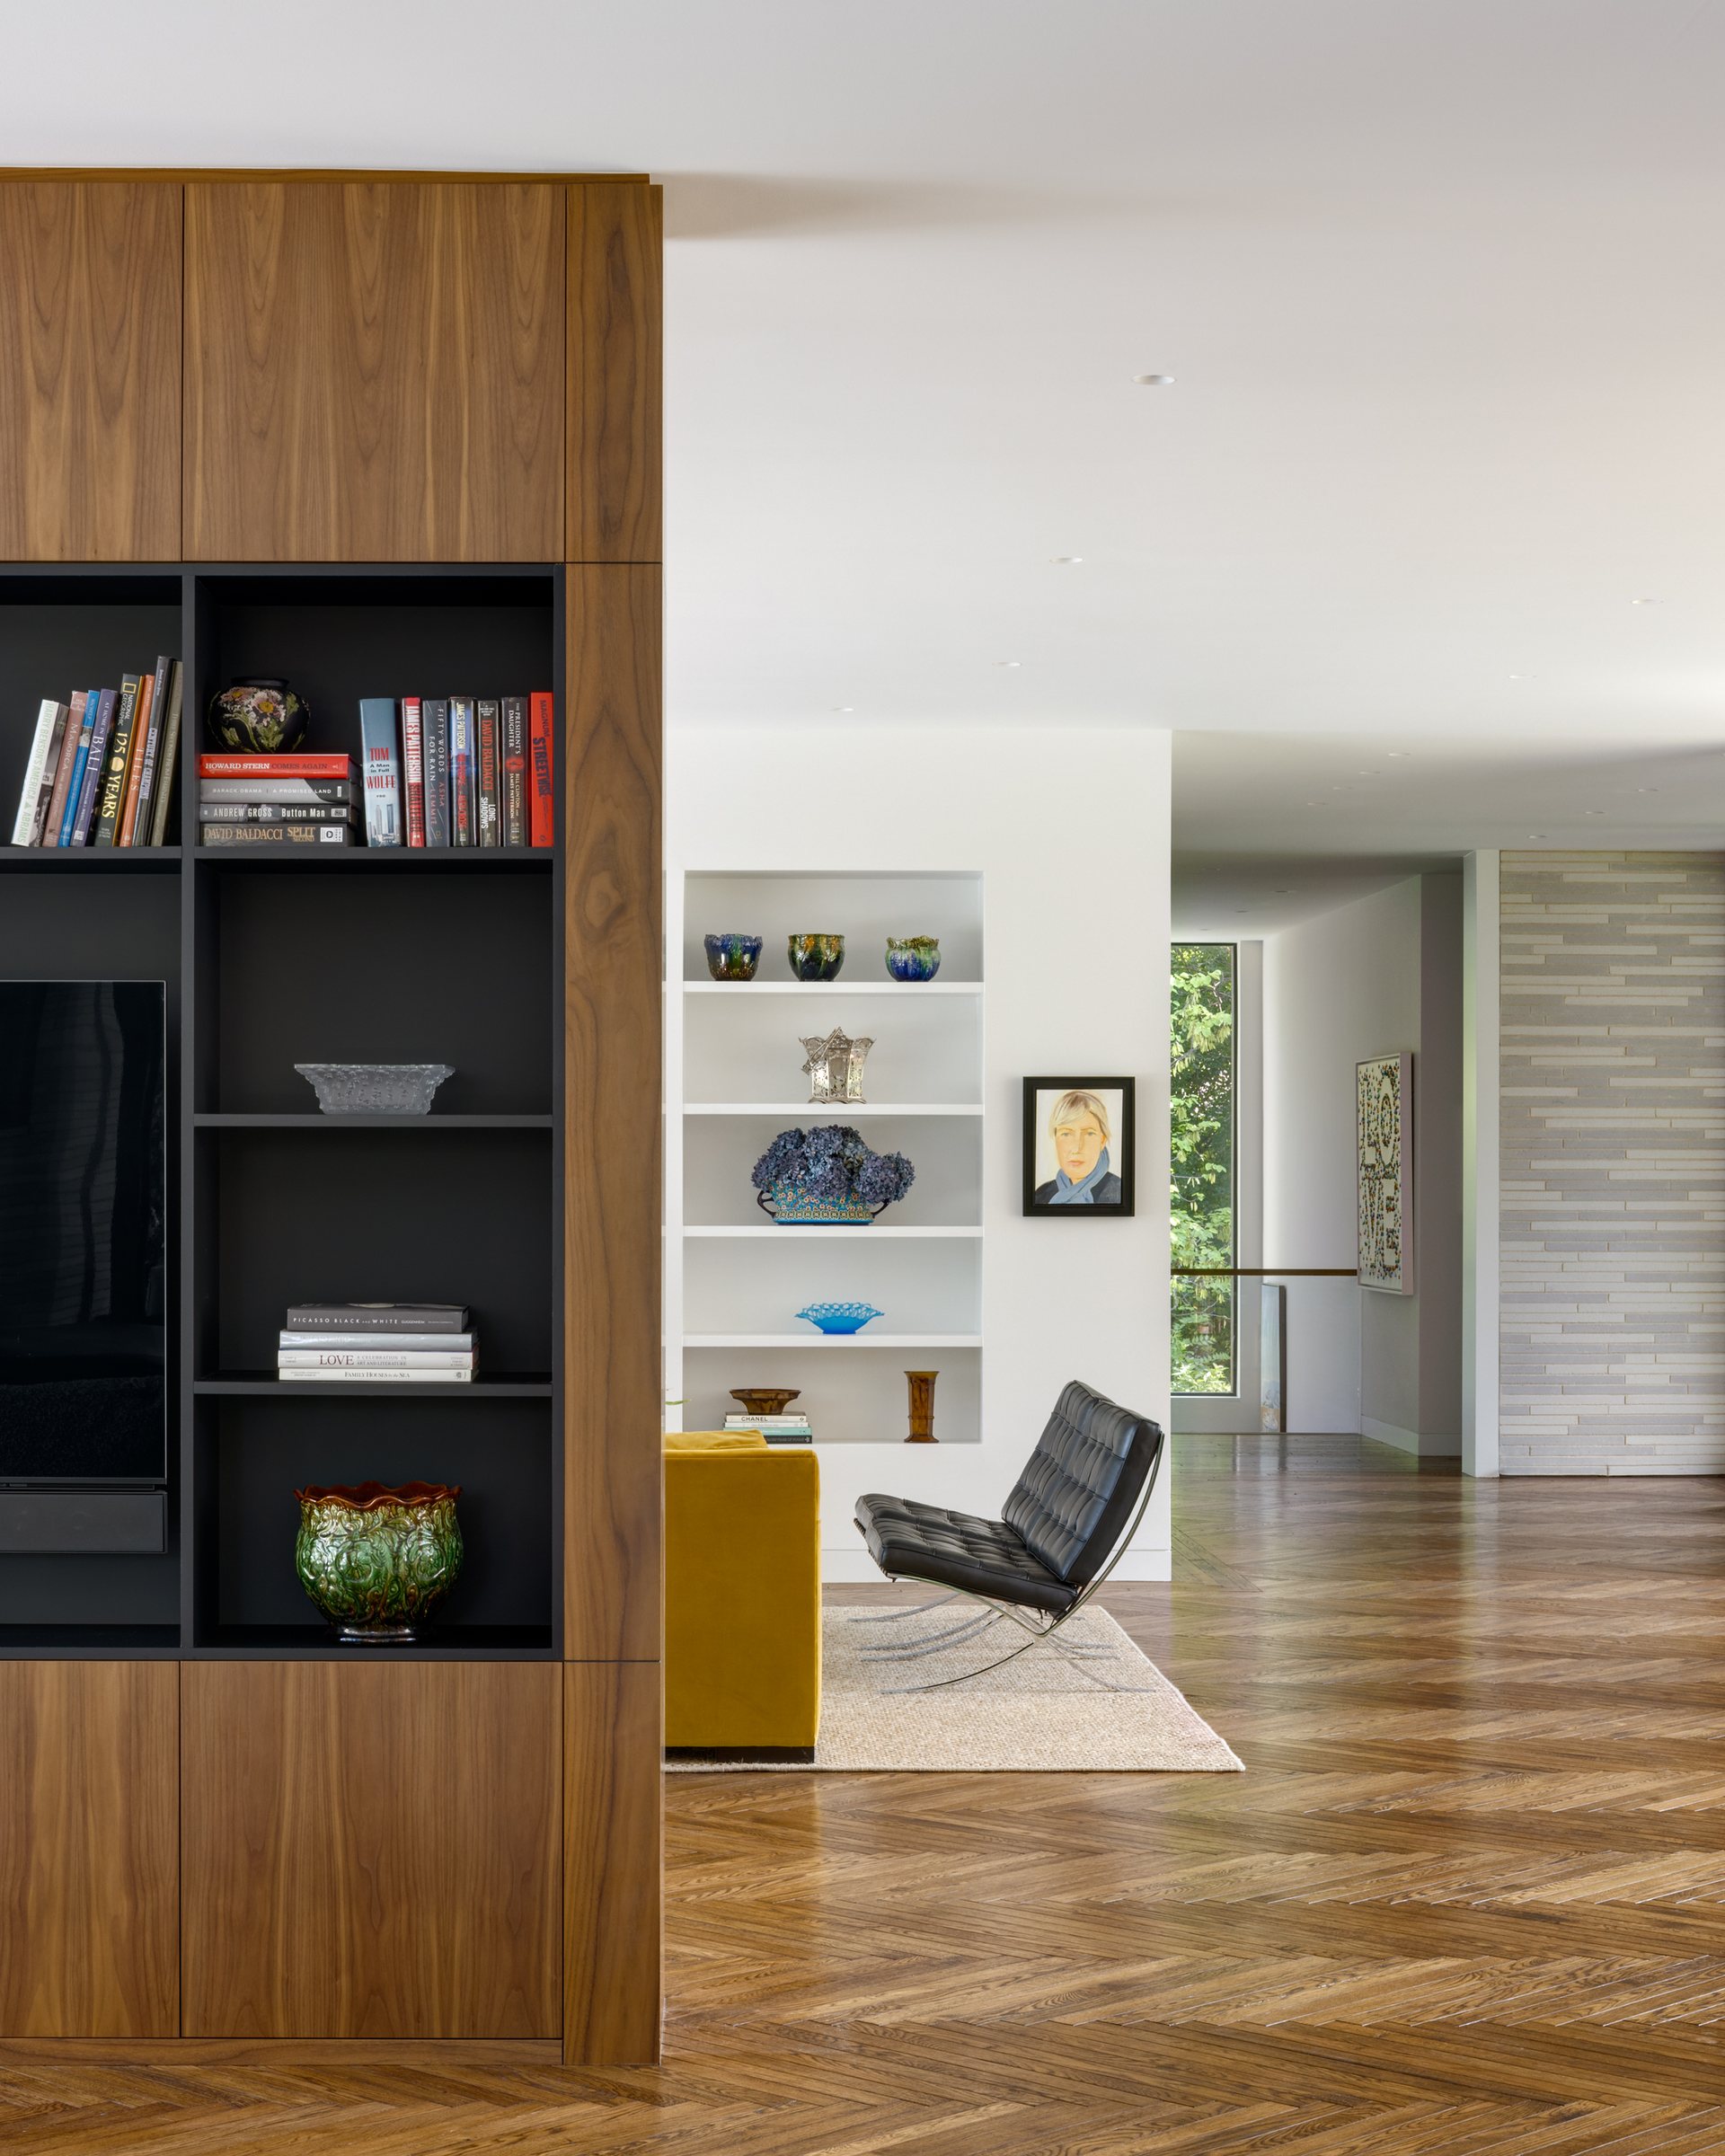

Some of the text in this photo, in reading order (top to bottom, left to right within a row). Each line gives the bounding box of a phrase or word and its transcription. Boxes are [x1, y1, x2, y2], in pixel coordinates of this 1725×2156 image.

[101, 711, 109, 727] HOME
[117, 694, 128, 726] GEOGRAPHIC
[124, 694, 134, 720] NATIONAL
[405, 706, 420, 733] JAMES
[456, 702, 465, 720] JAMES
[539, 700, 551, 737] MAGNUM
[62, 723, 79, 771] MAJORCA
[114, 731, 128, 755] 125
[456, 721, 465, 749] PATTERSON
[482, 720, 492, 746] DAVID
[87, 735, 104, 772] BALI
[139, 728, 158, 800] CENTURY OF CHAMPIONS
[370, 747, 389, 761] TOM
[406, 735, 421, 782] PATTERSON
[533, 738, 553, 797] STREETWISE
[18, 702, 54, 844] HARRY BENSON'S AMERICA ABRAMS
[130, 747, 146, 791] TILES
[367, 775, 395, 790] WOLFE
[482, 748, 493, 791] BALDACCI
[101, 773, 122, 819] YEARS
[214, 808, 244, 817] ANDREW
[248, 808, 272, 817] GROSS
[281, 808, 306, 817] Button
[310, 808, 325, 817] Man
[481, 797, 489, 828] SHADOWS
[204, 826, 315, 840] DAVID BALDACCI SPLIT
[320, 1355, 354, 1365] LOVE
